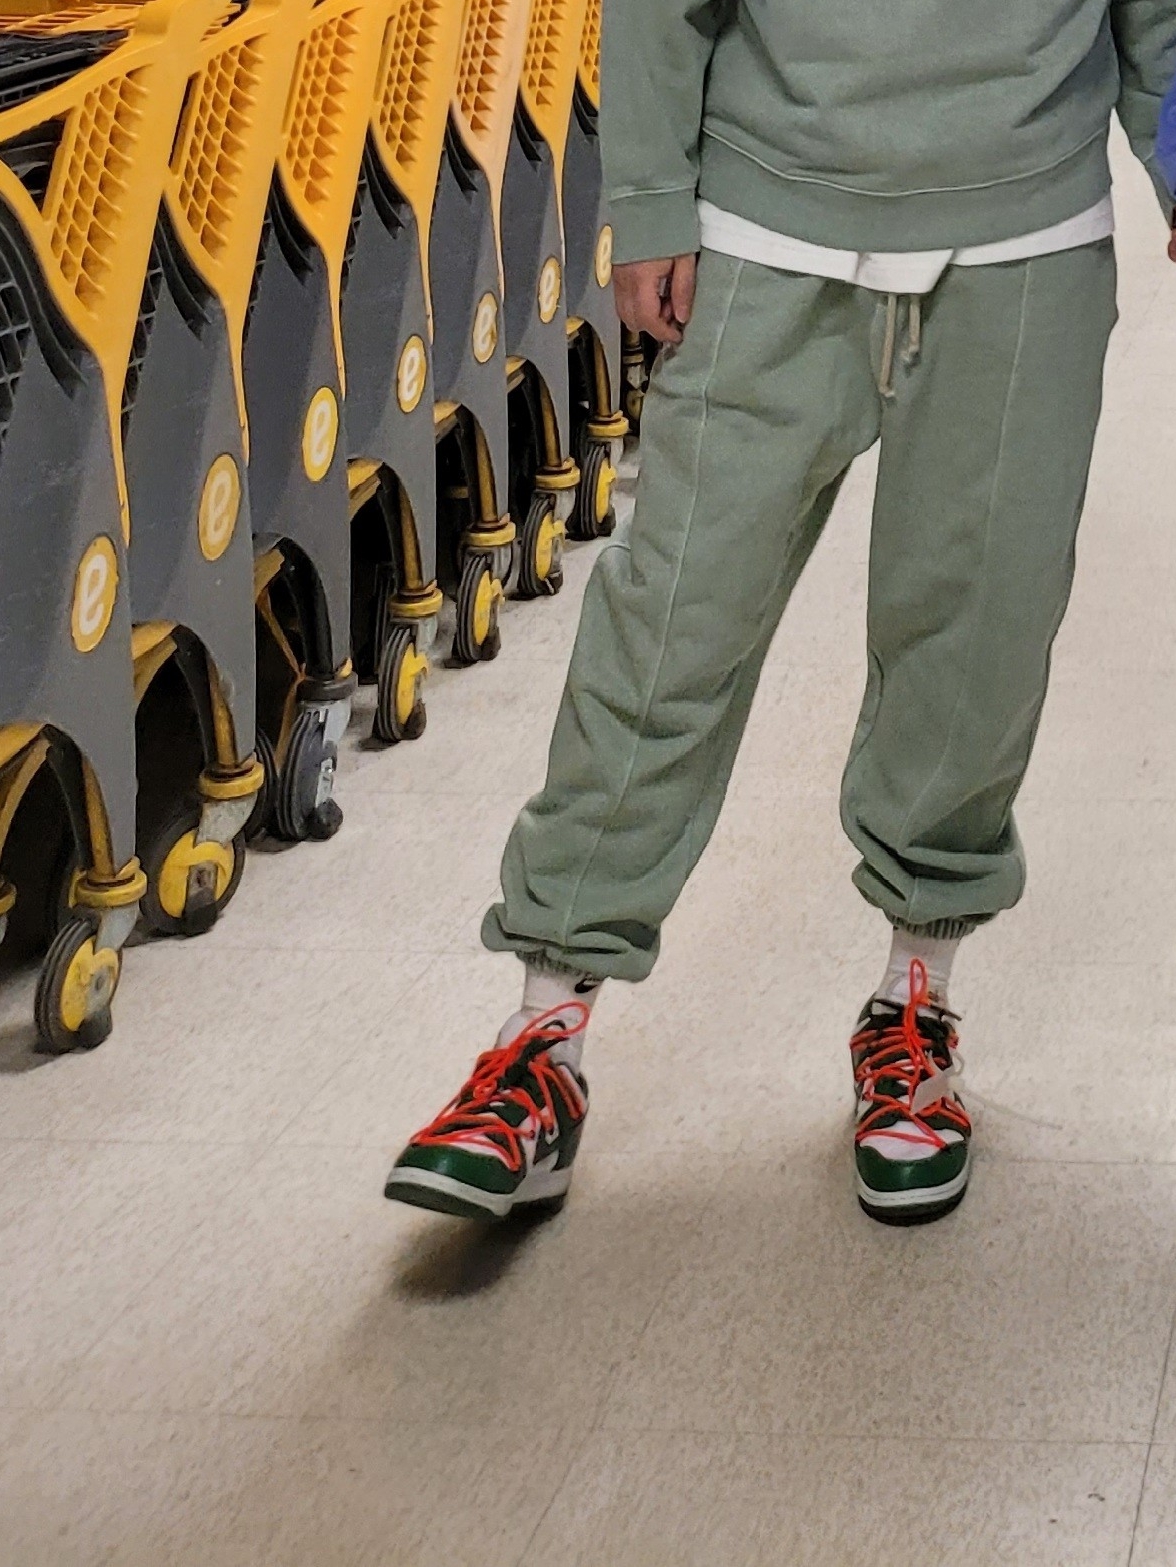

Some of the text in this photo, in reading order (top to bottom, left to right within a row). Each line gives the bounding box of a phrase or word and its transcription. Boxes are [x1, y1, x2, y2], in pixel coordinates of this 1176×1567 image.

[540, 265, 556, 310] e
[477, 301, 492, 354] e
[403, 341, 421, 404] e
[310, 400, 332, 467] e
[207, 470, 232, 553] e
[79, 553, 108, 635] e
